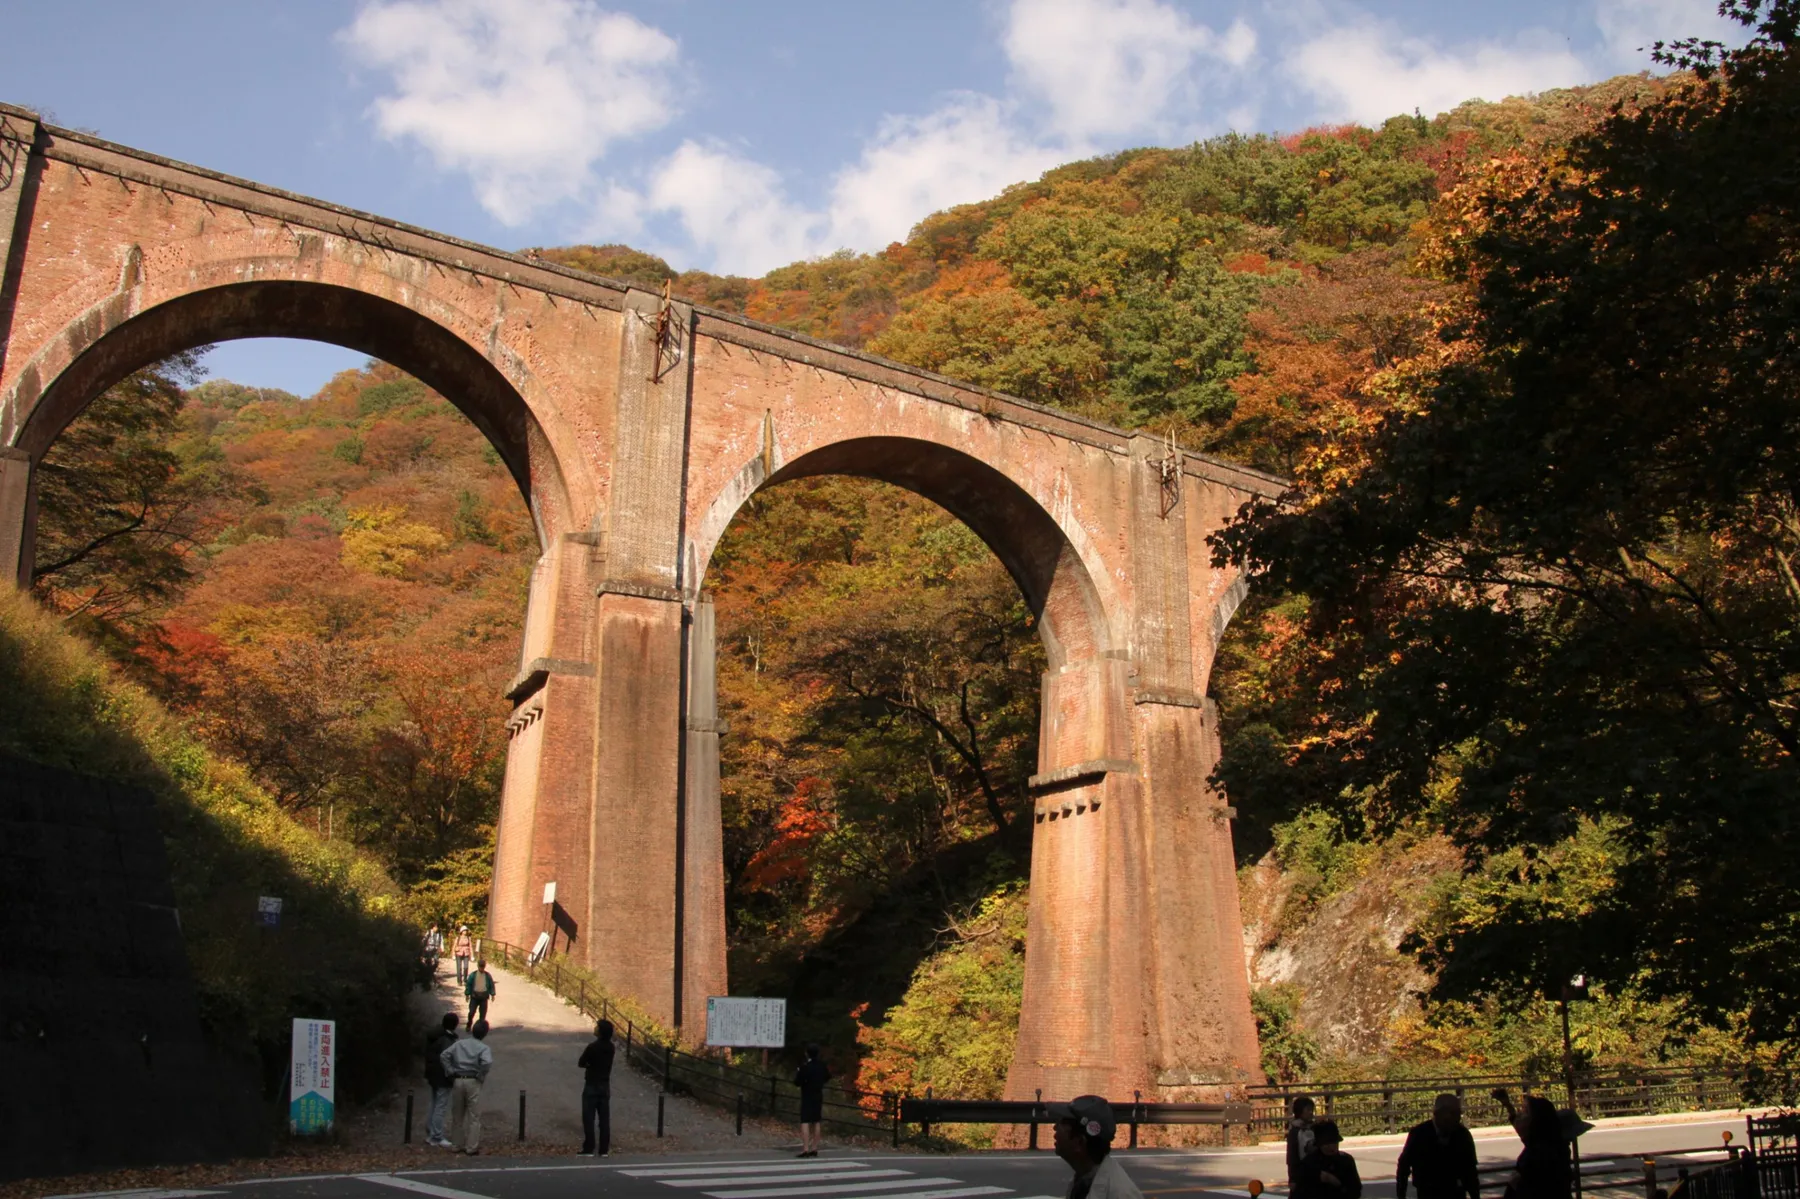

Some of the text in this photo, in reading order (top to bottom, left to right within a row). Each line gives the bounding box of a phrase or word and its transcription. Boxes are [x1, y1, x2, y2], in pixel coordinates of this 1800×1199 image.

[320, 1024, 330, 1088] 車両進入禁止
